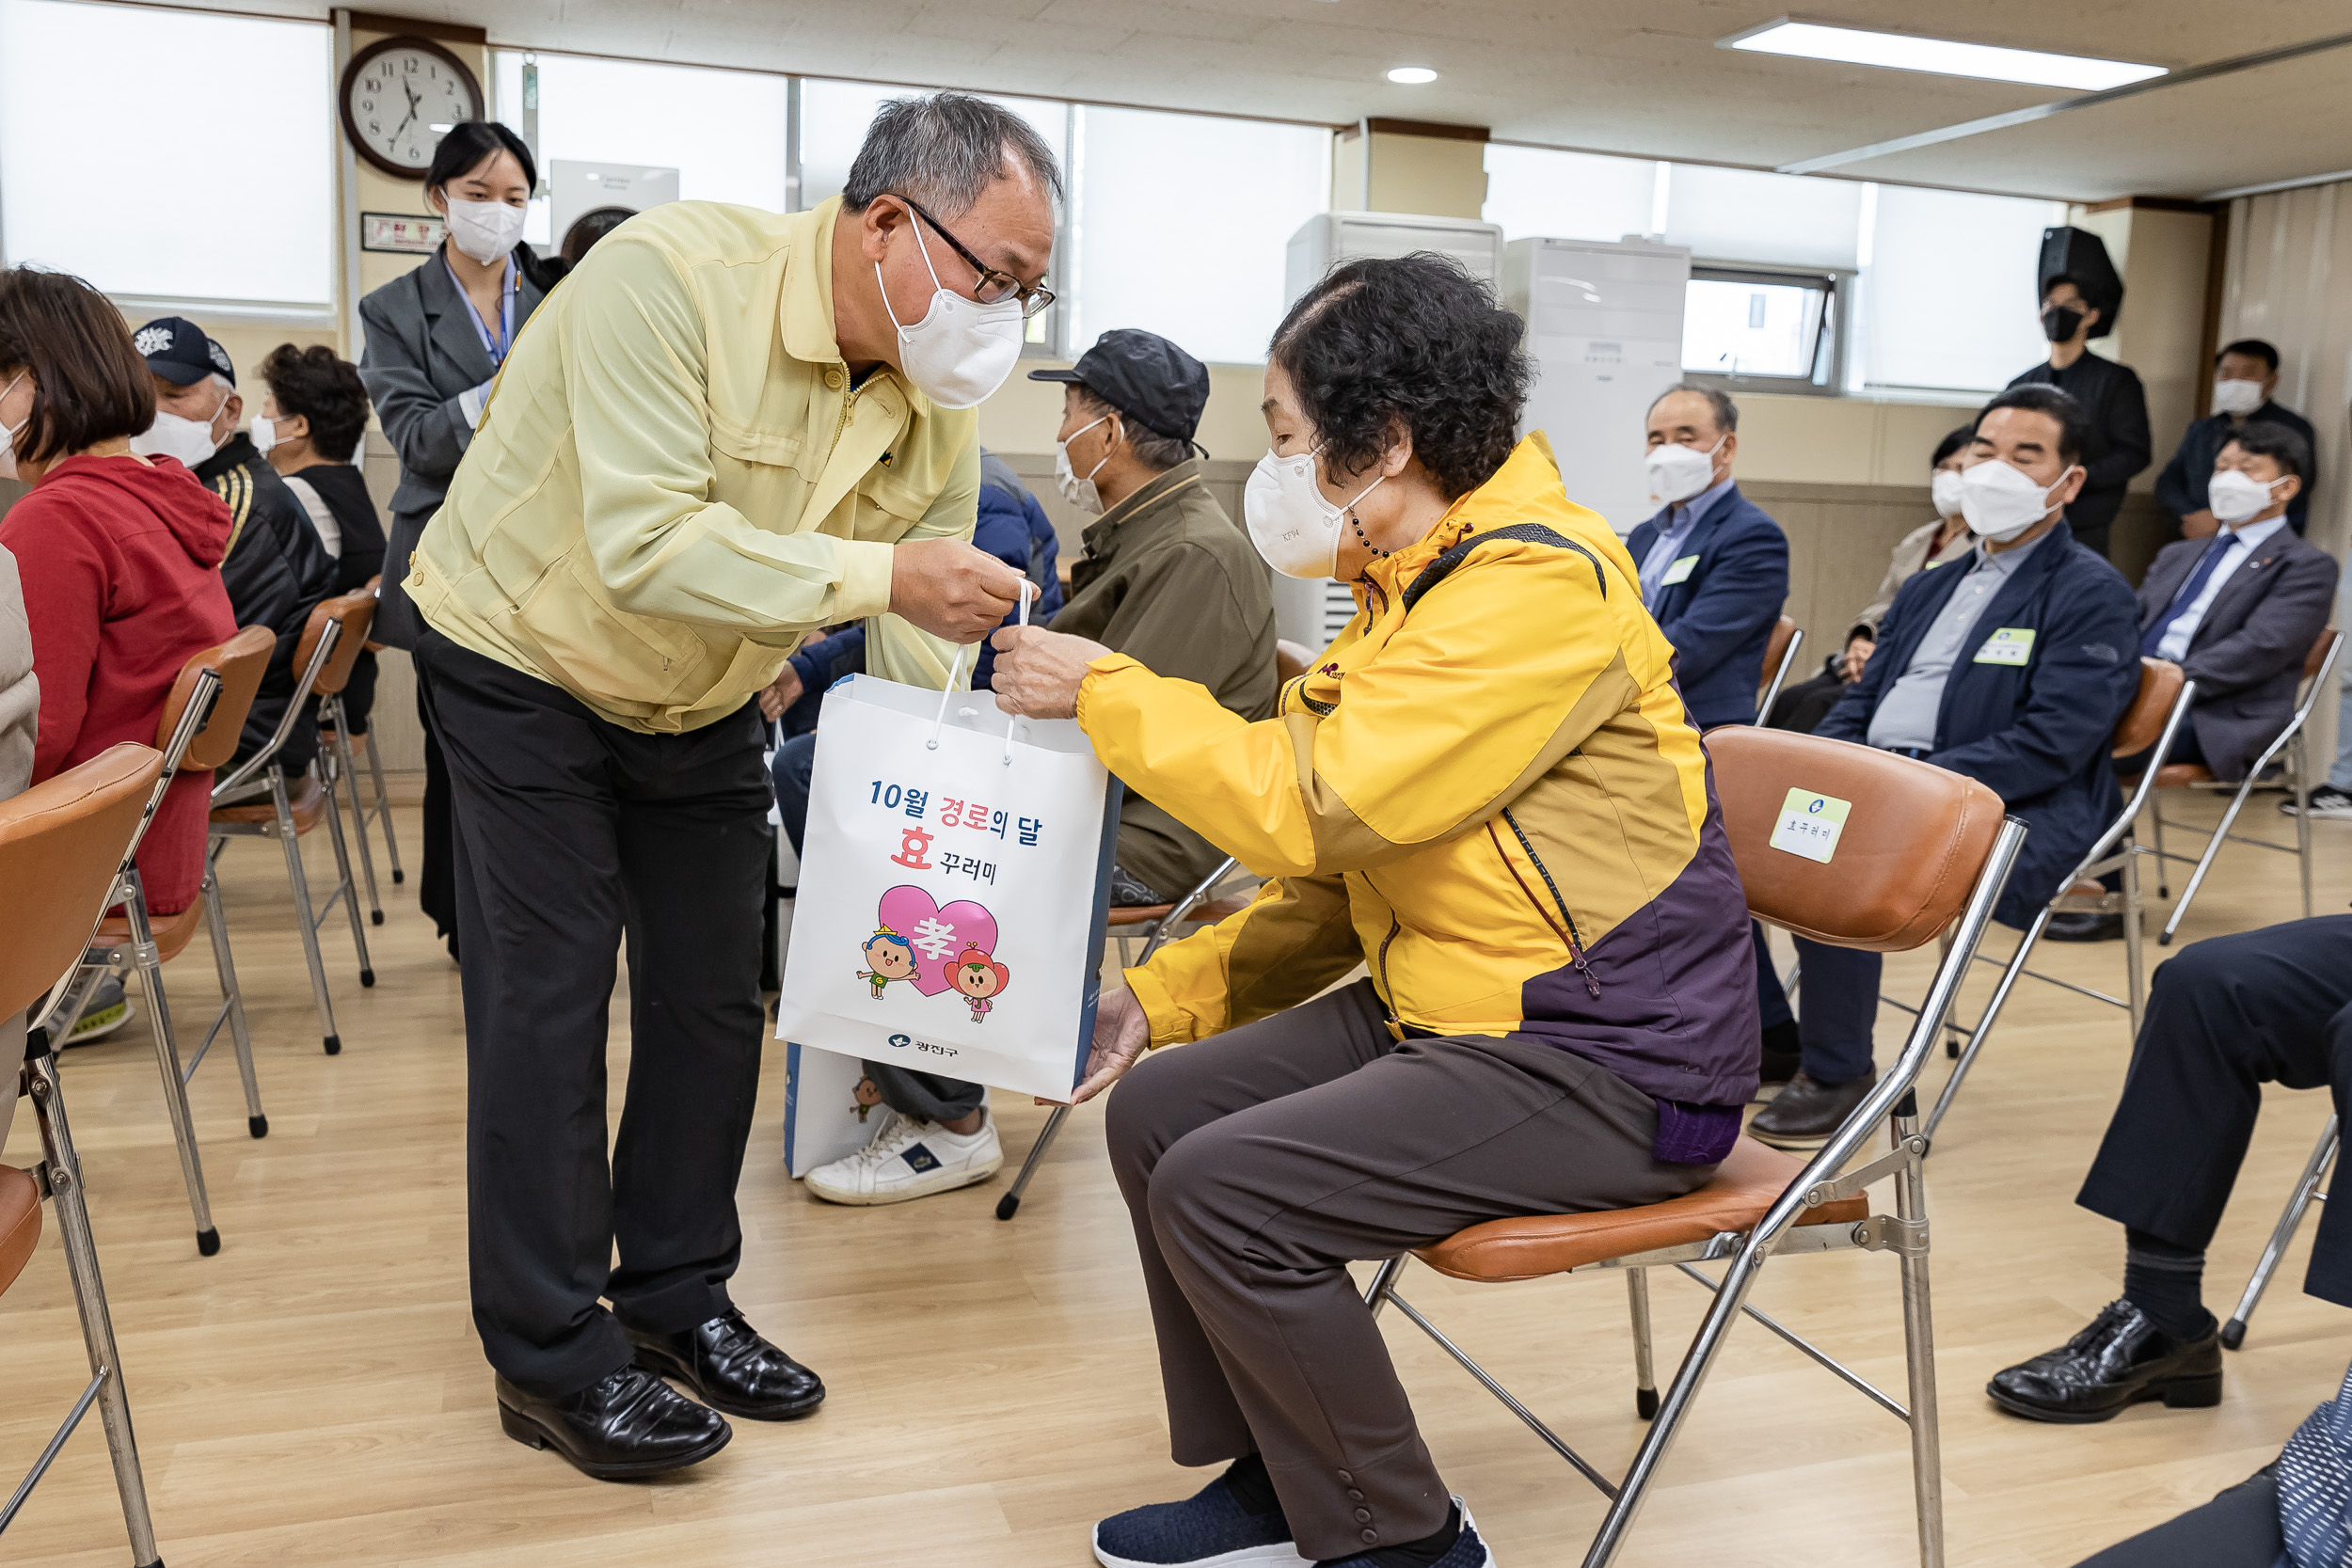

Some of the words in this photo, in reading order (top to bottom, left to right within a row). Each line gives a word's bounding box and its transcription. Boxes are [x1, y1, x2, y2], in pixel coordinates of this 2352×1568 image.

[381, 61, 394, 77] 11
[403, 56, 419, 73] 12
[430, 64, 437, 80] 1
[365, 77, 382, 94] 10
[446, 79, 455, 96] 2
[362, 99, 374, 113] 9
[452, 103, 463, 121] 3
[369, 119, 381, 135] 8
[408, 145, 421, 160] 6
[1282, 529, 1300, 543] KF94
[870, 780, 929, 819] 10월
[940, 797, 1009, 840] 경로의
[1018, 816, 1043, 847] 달
[890, 826, 934, 870] 효
[940, 852, 997, 886] 꾸러미
[912, 916, 957, 960] 孝
[914, 1040, 960, 1057] 광진구
